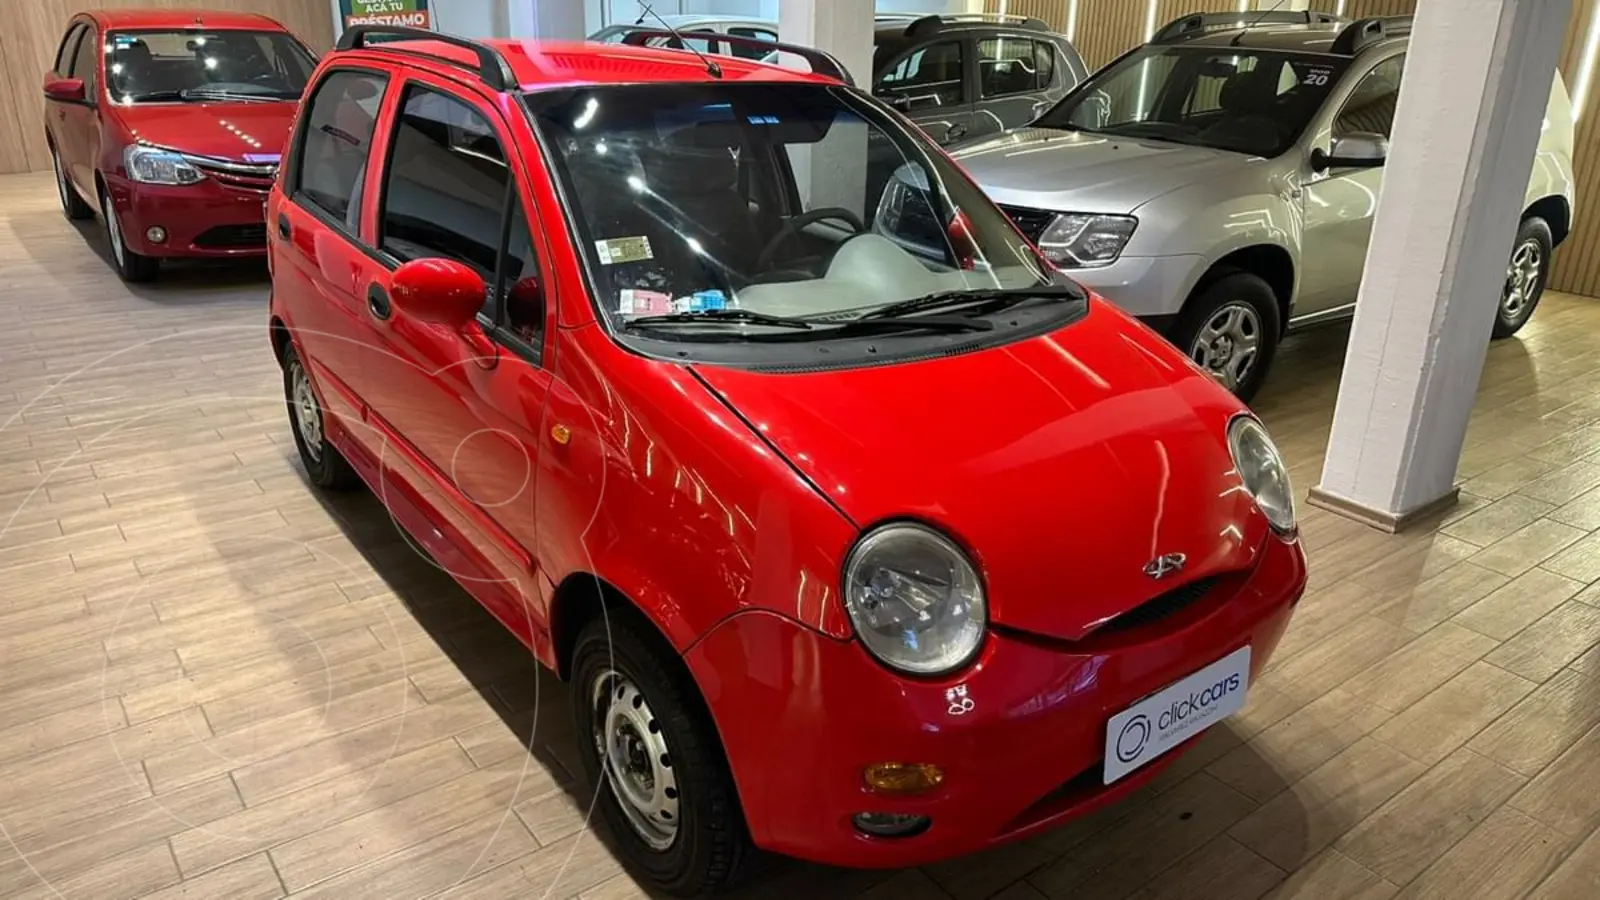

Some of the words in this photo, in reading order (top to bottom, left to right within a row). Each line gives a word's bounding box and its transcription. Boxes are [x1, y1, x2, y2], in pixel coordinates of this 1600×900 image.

[389, 2, 404, 12] TU
[1302, 74, 1328, 86] 20
[1158, 673, 1239, 730] clickcars
